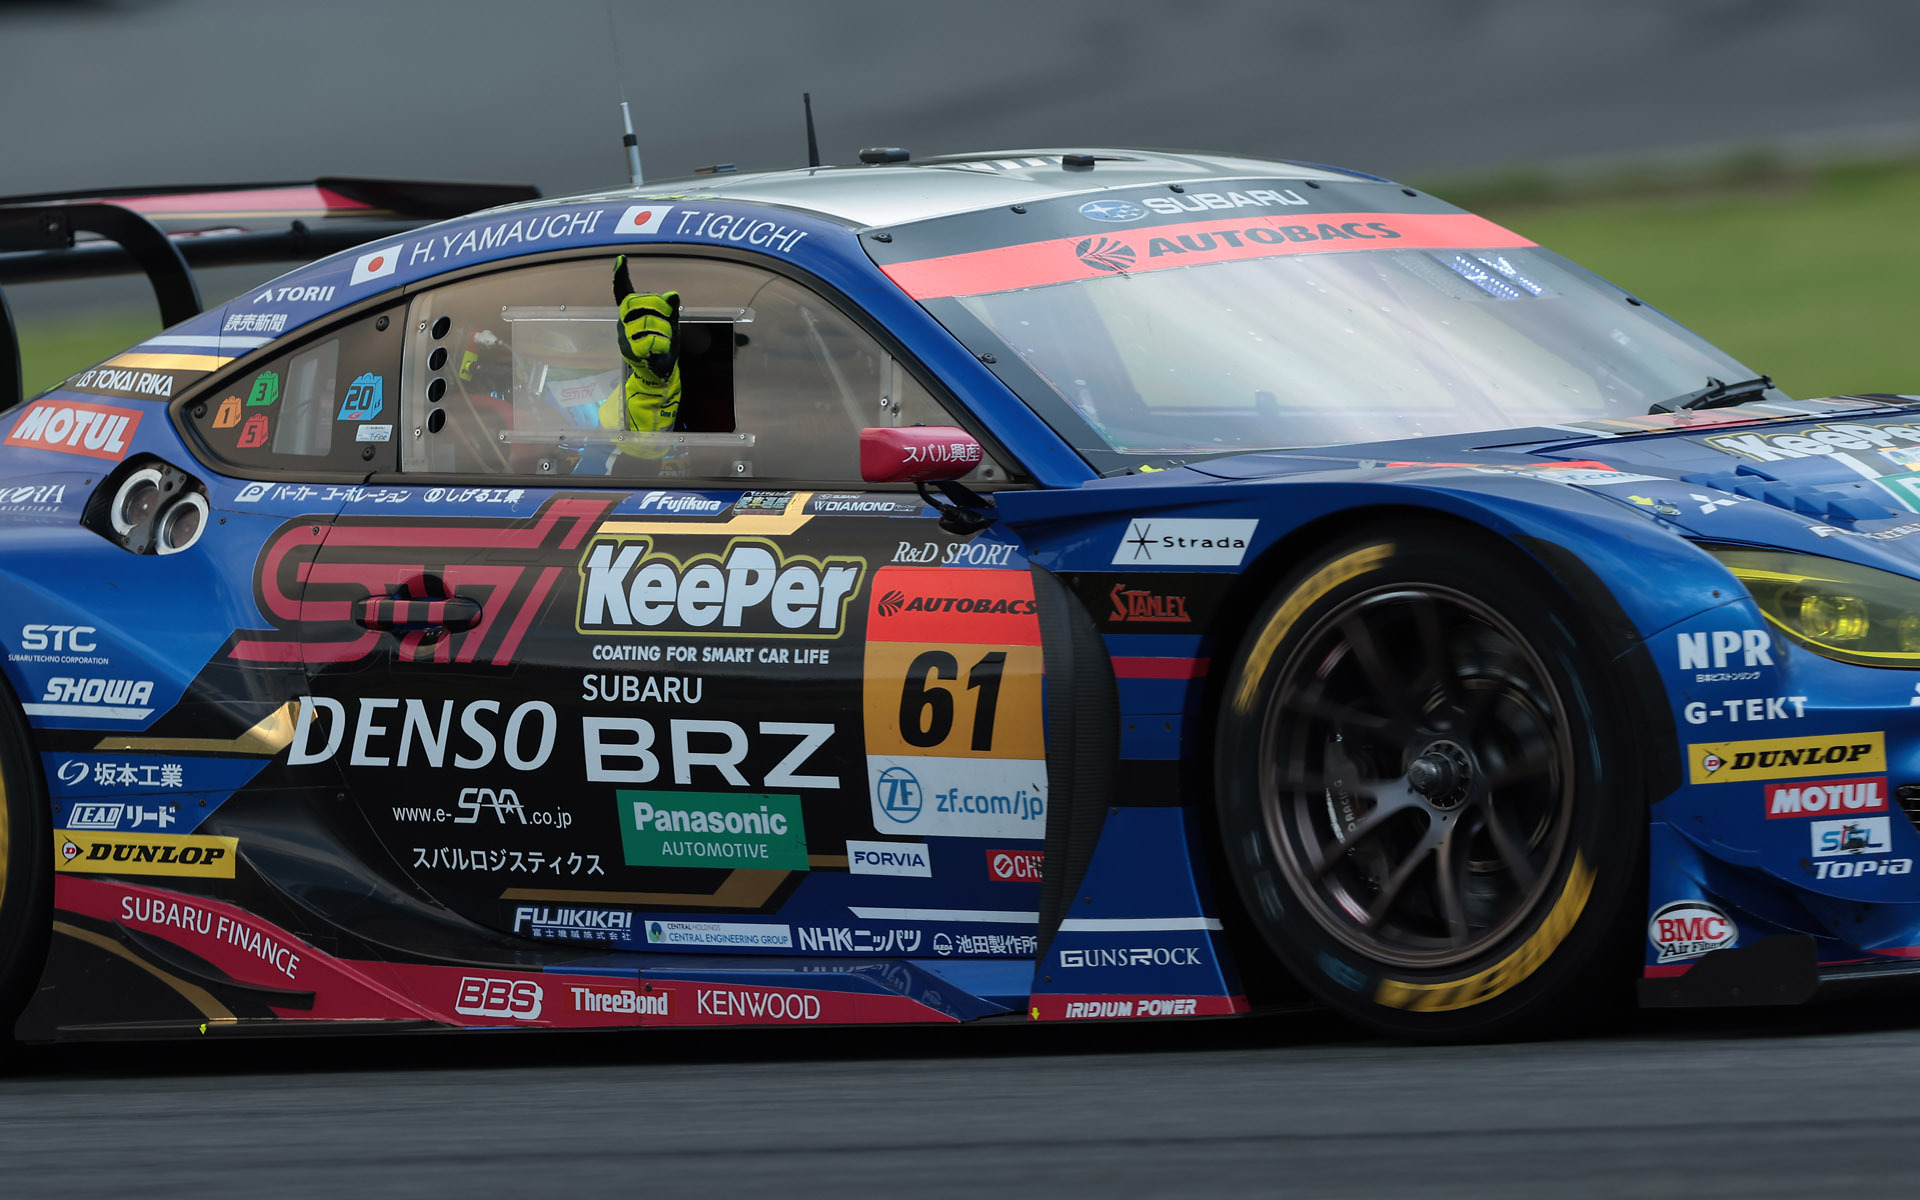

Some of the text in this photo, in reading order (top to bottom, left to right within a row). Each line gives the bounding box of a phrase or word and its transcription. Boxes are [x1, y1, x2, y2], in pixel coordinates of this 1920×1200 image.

[1142, 188, 1308, 215] SUBARU
[409, 210, 604, 266] H.YAMAUCHI
[674, 210, 808, 254] T.IGUCHI
[1148, 222, 1402, 259] AUTOBACS
[277, 286, 335, 302] TORII
[223, 313, 288, 332] 読売新聞
[92, 370, 174, 396] TOKAI RIKA
[256, 382, 268, 401] 3
[345, 386, 376, 410] 20
[223, 408, 230, 424] 1
[12, 406, 130, 453] MOTUL
[246, 425, 258, 443] 5
[902, 443, 980, 463] スバル興産
[1713, 424, 1920, 462] KeePe
[270, 486, 412, 503] パーカー コーポレーション
[445, 489, 525, 504] しげる工業
[656, 495, 722, 513] Fujikura
[891, 541, 1019, 566] R&D SPORT
[1163, 536, 1246, 549] Strada
[583, 544, 858, 629] KeePer
[905, 597, 1038, 615] AUTOBACS
[22, 624, 97, 652] STC
[1677, 629, 1774, 670] NPR
[8, 654, 109, 665] SUBARU TECHNO CORPORATION
[592, 645, 829, 664] COATING FOR SMART CAR LIFE
[42, 676, 155, 705] SHOWA
[582, 674, 703, 704] SUBARU
[899, 650, 1008, 752] 61
[1683, 696, 1808, 724] G-TEKT
[287, 695, 558, 771] DENSO
[582, 716, 841, 789] BRZ
[1730, 744, 1872, 771] DUNLOP
[94, 763, 183, 788] 坂本工業
[935, 788, 1044, 821] zf.com/jp
[1770, 782, 1884, 814] MOTUL
[74, 805, 176, 828] LEAD リード
[633, 801, 788, 836] Panasonic
[85, 843, 225, 865] DUNLOP
[412, 847, 605, 876] スバルロジスティクス
[661, 841, 769, 860] AUTOMOTIVE
[854, 851, 926, 868] FORVIA
[514, 907, 632, 933] FUJIKIKAI
[667, 923, 693, 931] CENTRAL
[1658, 916, 1726, 942] BMC
[121, 896, 300, 979] SUBARU FINANCE
[669, 933, 788, 945] CENTRAL ENGINEERING GROUP
[956, 935, 1038, 954] 池田製作所
[1663, 942, 1689, 957] Air
[455, 976, 544, 1020] BBS
[571, 987, 668, 1016] ThreeBond
[698, 990, 821, 1020] KENWOOD
[1065, 999, 1197, 1019] IRIDIUM POWER
